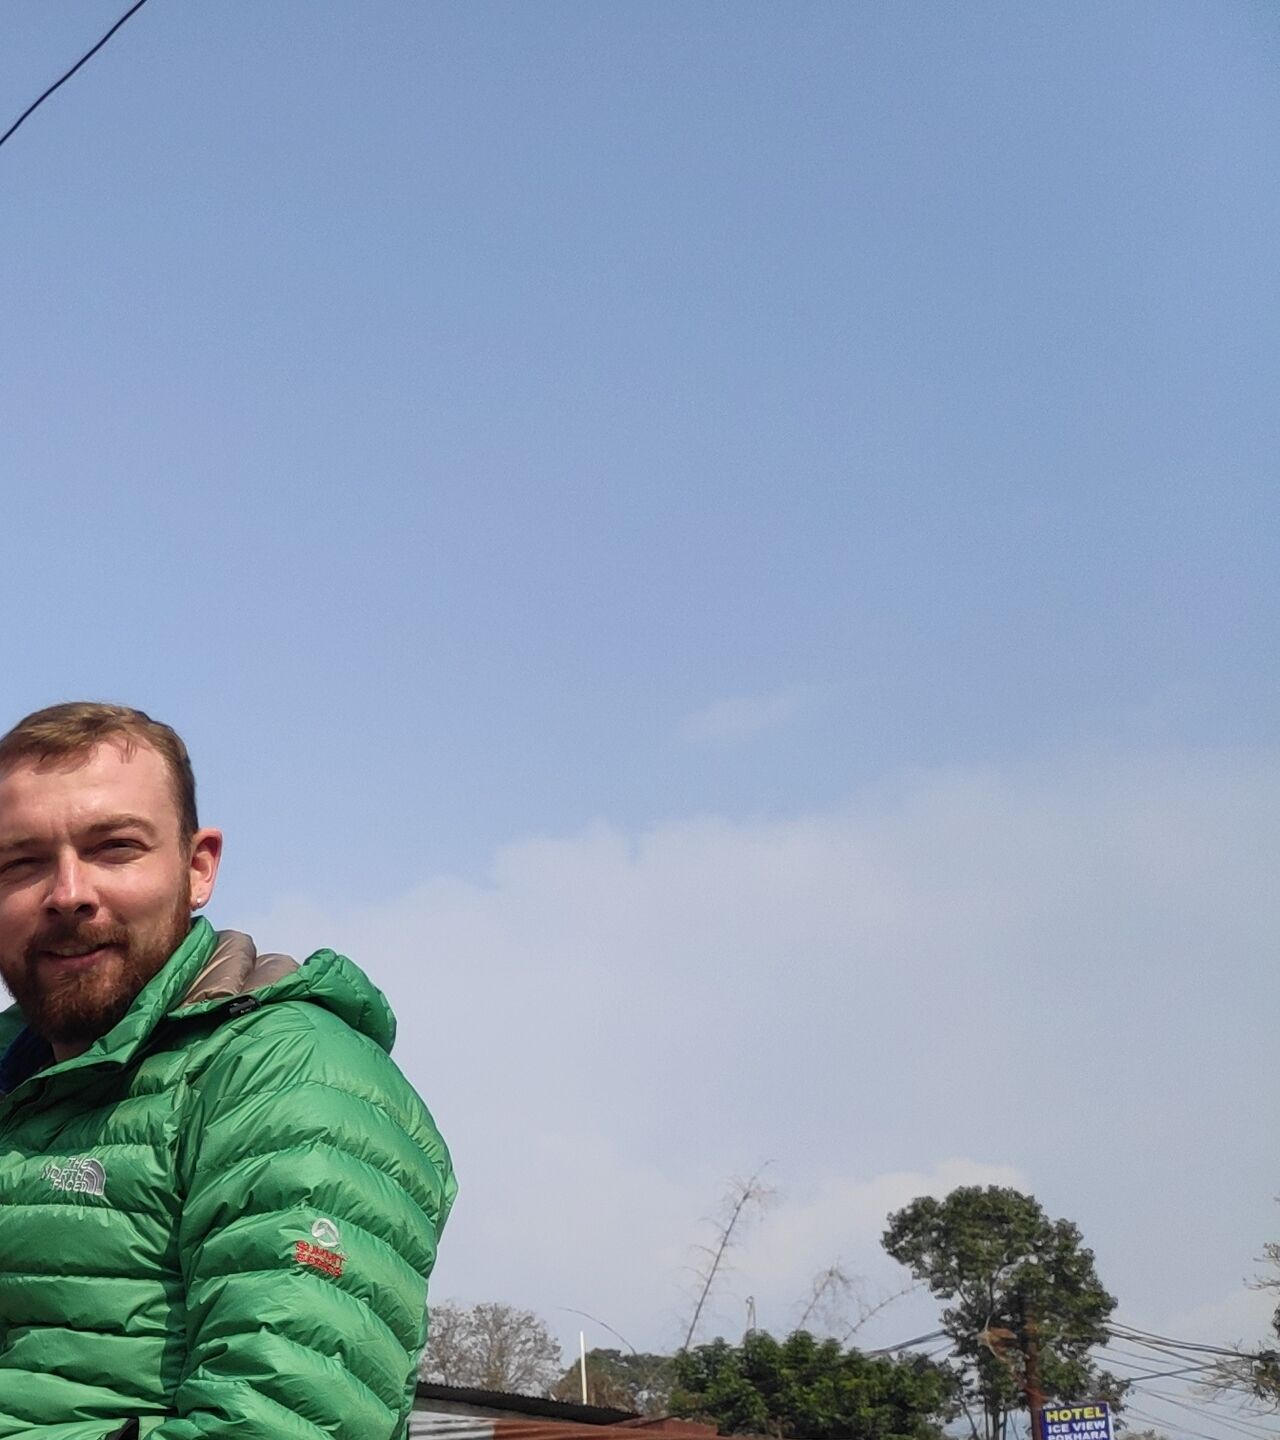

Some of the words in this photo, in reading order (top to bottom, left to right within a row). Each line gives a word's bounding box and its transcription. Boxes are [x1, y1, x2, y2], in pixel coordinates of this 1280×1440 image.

[67, 1157, 91, 1169] THE
[41, 1164, 86, 1181] NORTH
[51, 1179, 80, 1192] FACE
[1045, 1406, 1106, 1423] HOTEL
[1047, 1424, 1070, 1434] ICE
[1072, 1420, 1106, 1432] VIEW
